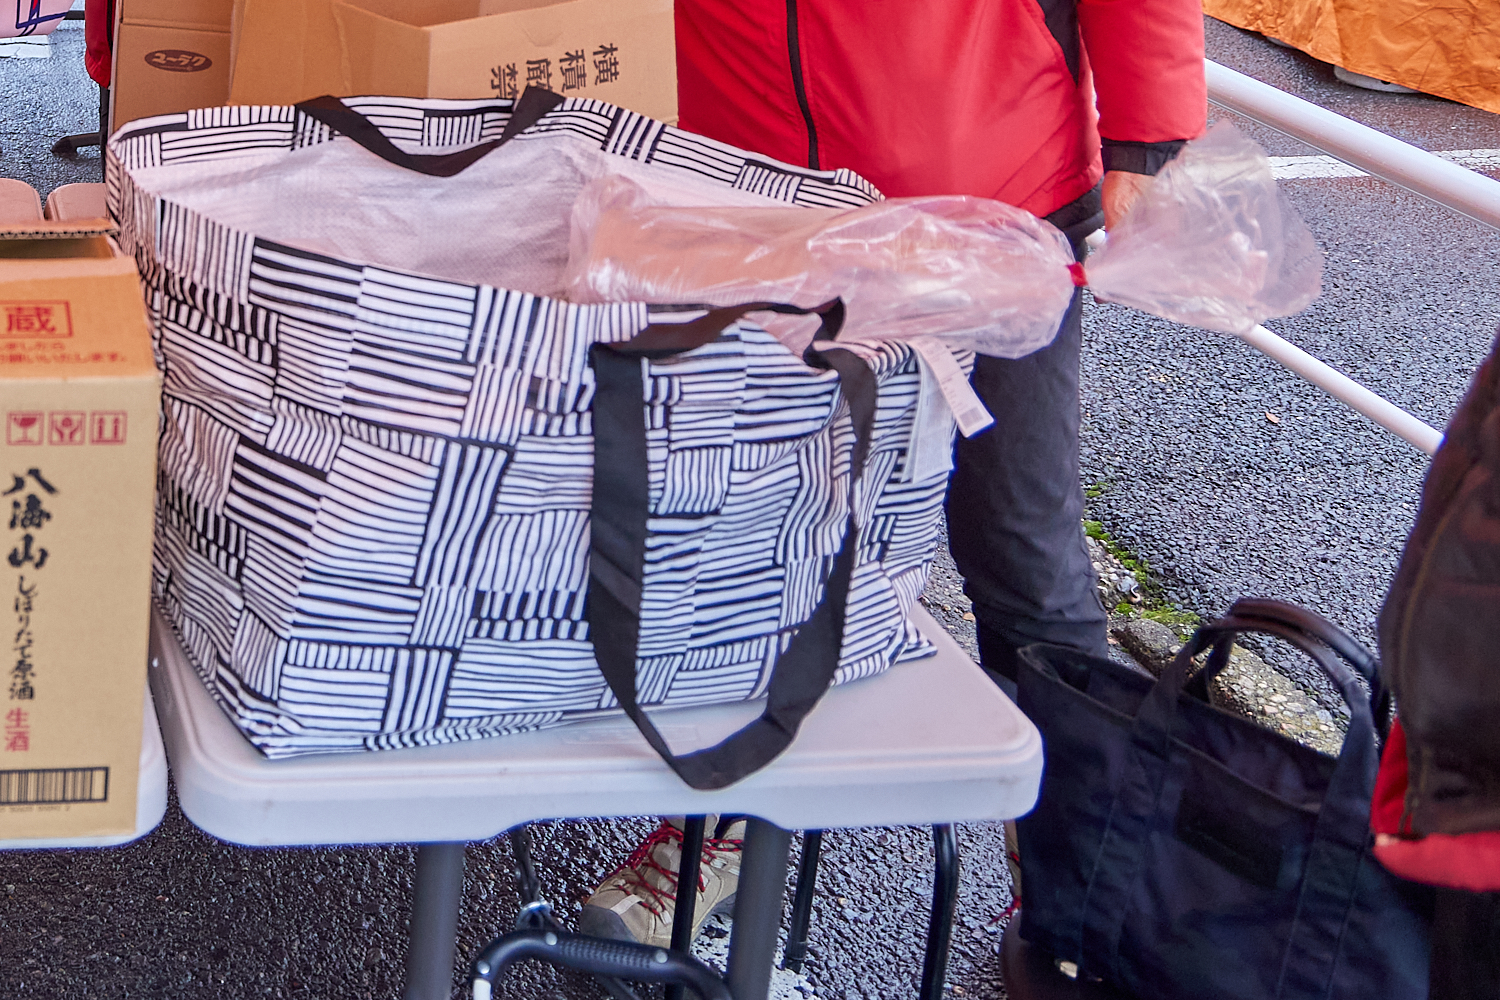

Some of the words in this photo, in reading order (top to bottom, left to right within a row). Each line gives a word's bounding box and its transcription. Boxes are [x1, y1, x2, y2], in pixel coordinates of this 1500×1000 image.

[2, 467, 59, 570] 八海山
[4, 706, 31, 752] 生酒
